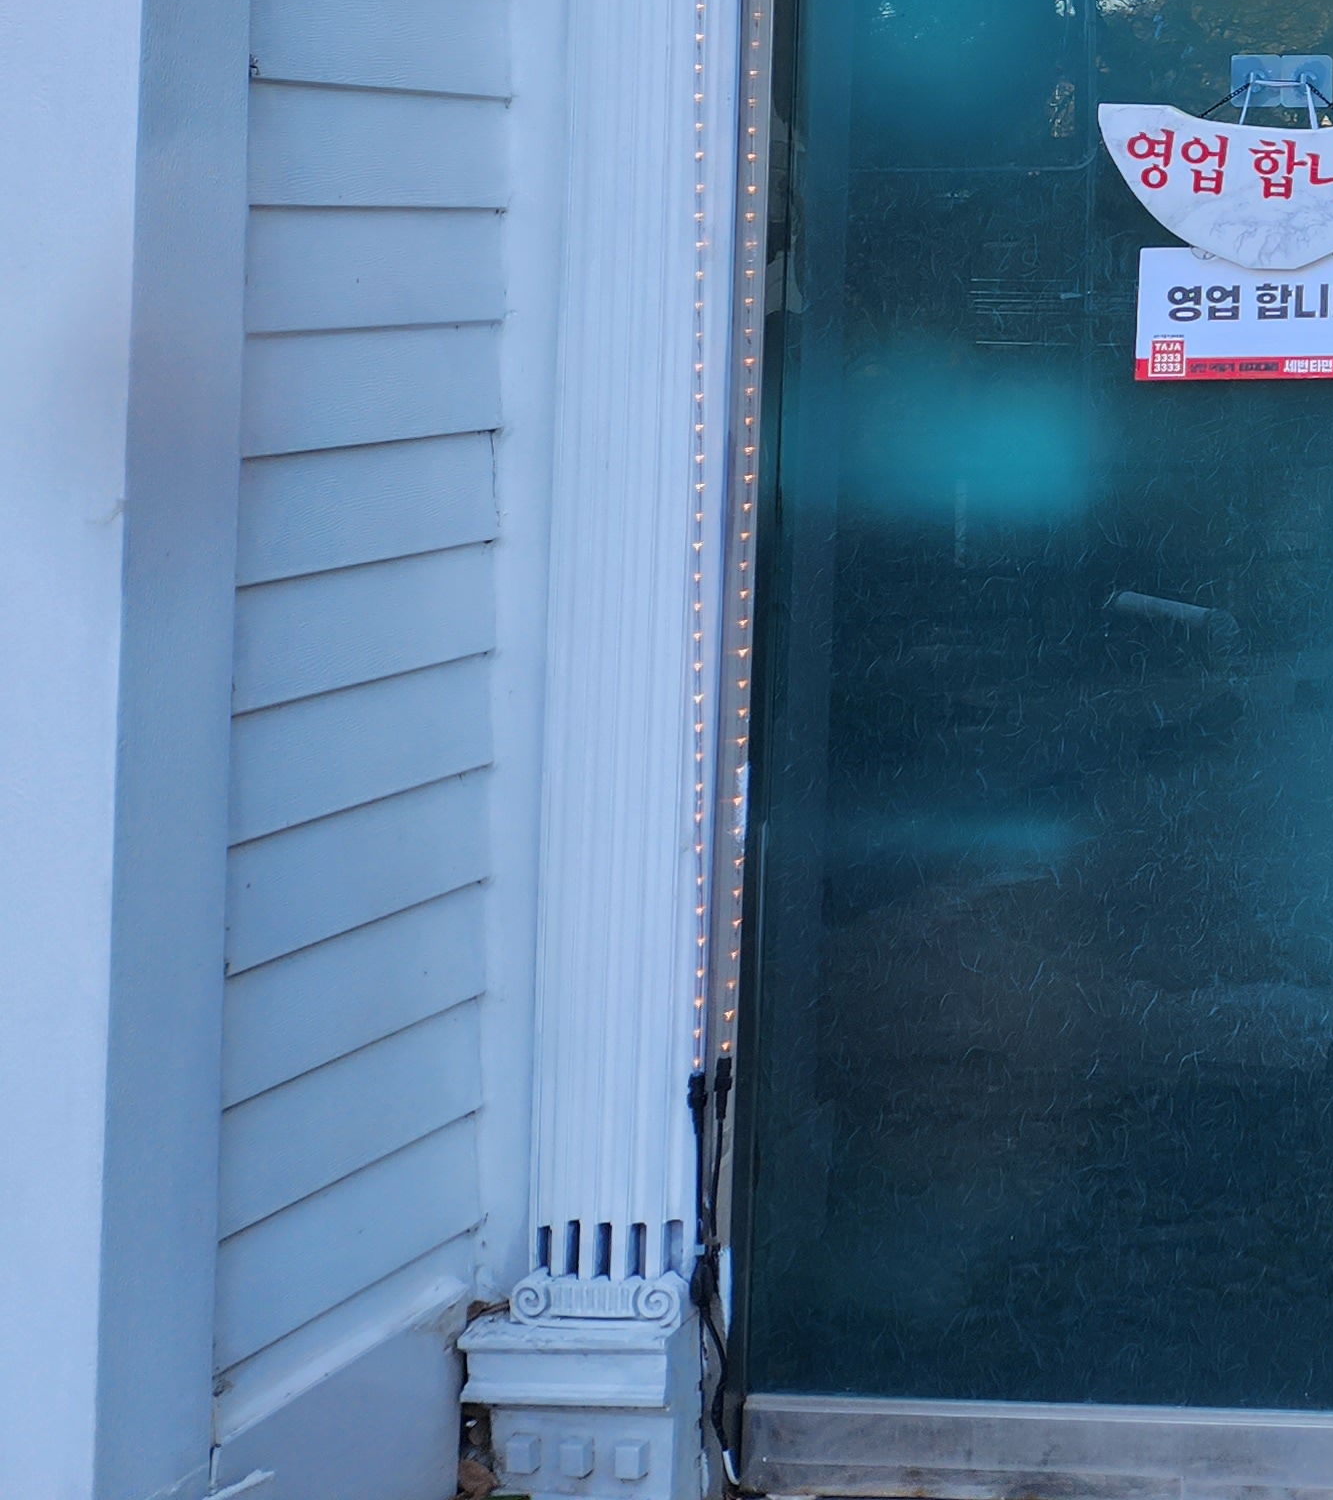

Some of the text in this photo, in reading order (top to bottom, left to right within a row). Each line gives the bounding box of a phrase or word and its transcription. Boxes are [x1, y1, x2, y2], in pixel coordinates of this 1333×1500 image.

[1127, 129, 1229, 195] 영업
[1167, 285, 1241, 322] 영업
[1154, 343, 1181, 351] TAJA
[1154, 353, 1181, 362] 3333
[1154, 363, 1181, 372] 3333
